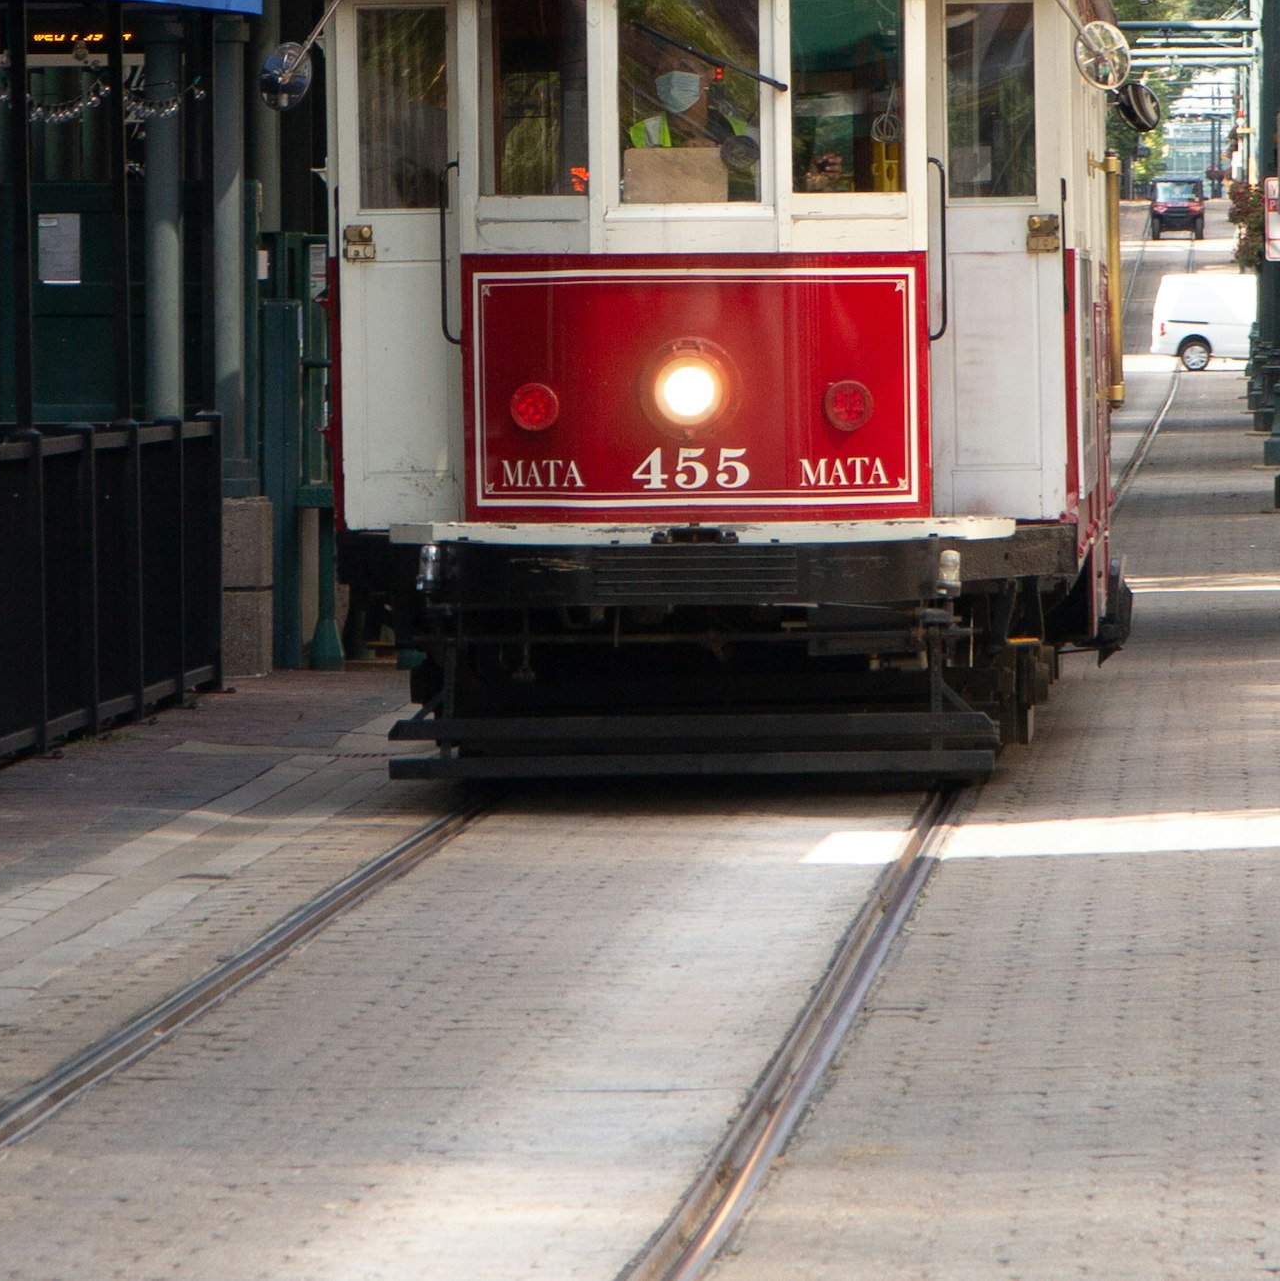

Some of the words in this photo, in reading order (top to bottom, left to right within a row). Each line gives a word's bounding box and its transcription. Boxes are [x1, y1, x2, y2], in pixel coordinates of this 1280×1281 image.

[501, 459, 586, 487] MATA
[632, 447, 750, 489] 455
[799, 457, 889, 486] MATA
